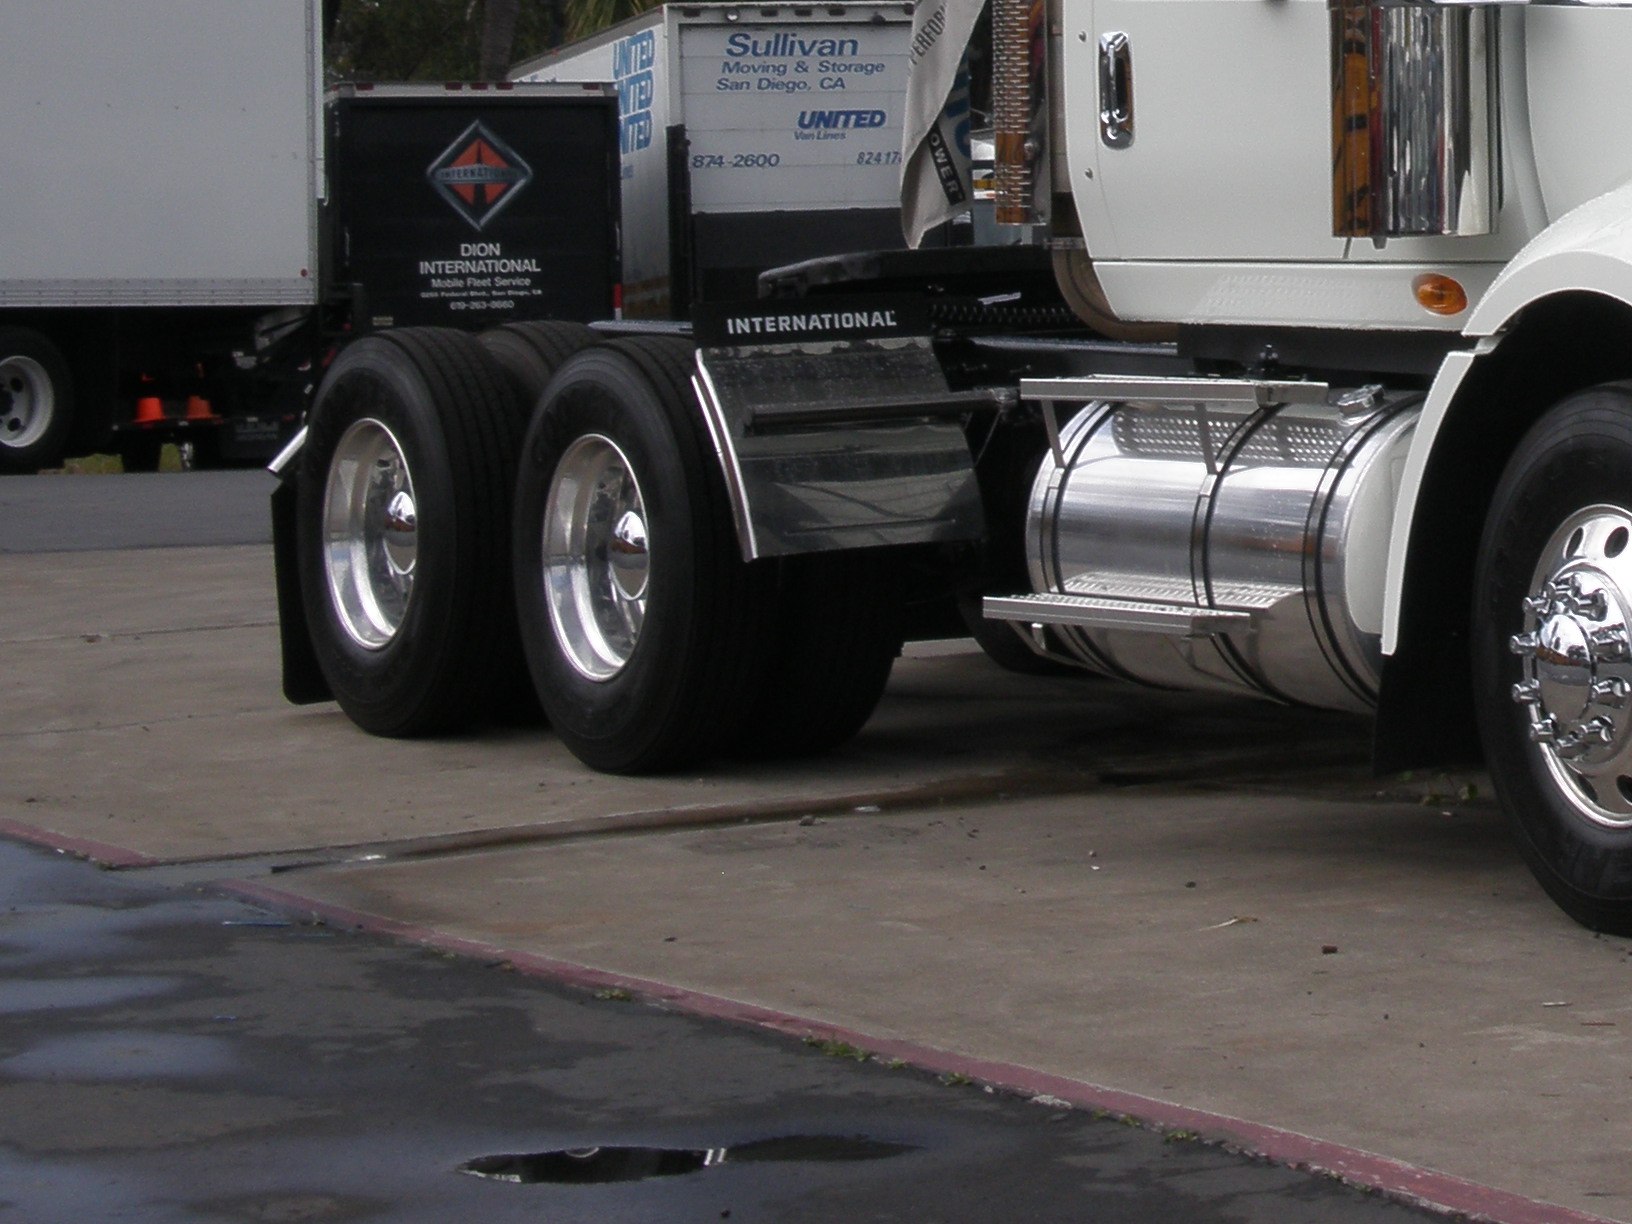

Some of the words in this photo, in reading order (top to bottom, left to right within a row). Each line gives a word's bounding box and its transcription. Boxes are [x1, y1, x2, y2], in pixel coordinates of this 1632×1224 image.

[612, 28, 656, 80] UNITED
[725, 32, 859, 57] Sullivan
[720, 60, 788, 77] Moving
[793, 60, 809, 74] &
[817, 60, 886, 76] Storage
[614, 68, 654, 116] NITED
[715, 77, 751, 91] San
[756, 77, 812, 94] Diego,
[818, 76, 846, 91] CA
[797, 109, 887, 130] UNITED
[794, 130, 815, 141] Van
[816, 130, 847, 141] Lines
[929, 131, 960, 194] OWER
[460, 243, 501, 257] DION
[419, 259, 542, 275] INTERNATIONAL
[431, 277, 465, 288] Mobile
[466, 277, 492, 287] Fleet
[494, 276, 532, 287] Service
[727, 310, 897, 335] INTERNATIONAL
